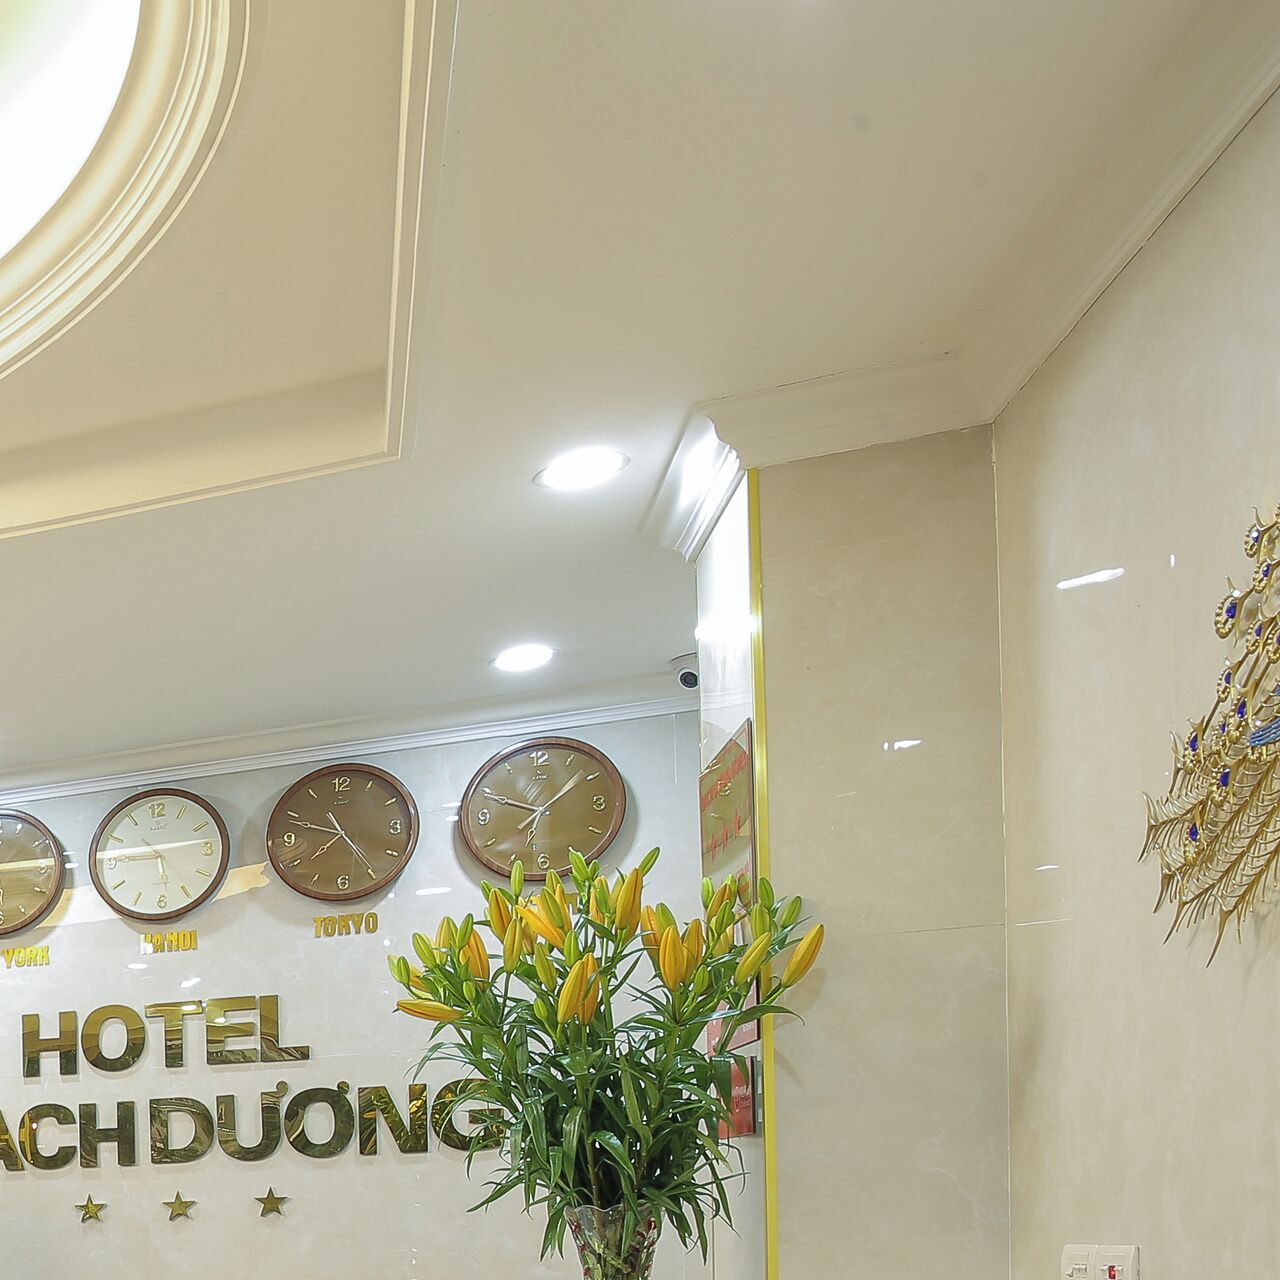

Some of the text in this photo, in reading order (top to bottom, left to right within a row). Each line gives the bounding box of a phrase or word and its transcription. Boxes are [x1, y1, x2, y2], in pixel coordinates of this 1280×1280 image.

[529, 750, 550, 766] 12
[331, 776, 351, 792] 12
[149, 802, 166, 819] 12
[591, 795, 606, 811] 3
[477, 808, 490, 825] 9
[389, 819, 401, 835] 3
[283, 832, 296, 847] 9
[201, 841, 213, 856] 3
[536, 853, 550, 869] 6
[337, 875, 350, 890] 6
[157, 894, 167, 908] 6
[313, 911, 379, 938] TOKYO
[2, 945, 50, 969] YORK
[21, 994, 311, 1079] HOTEL
